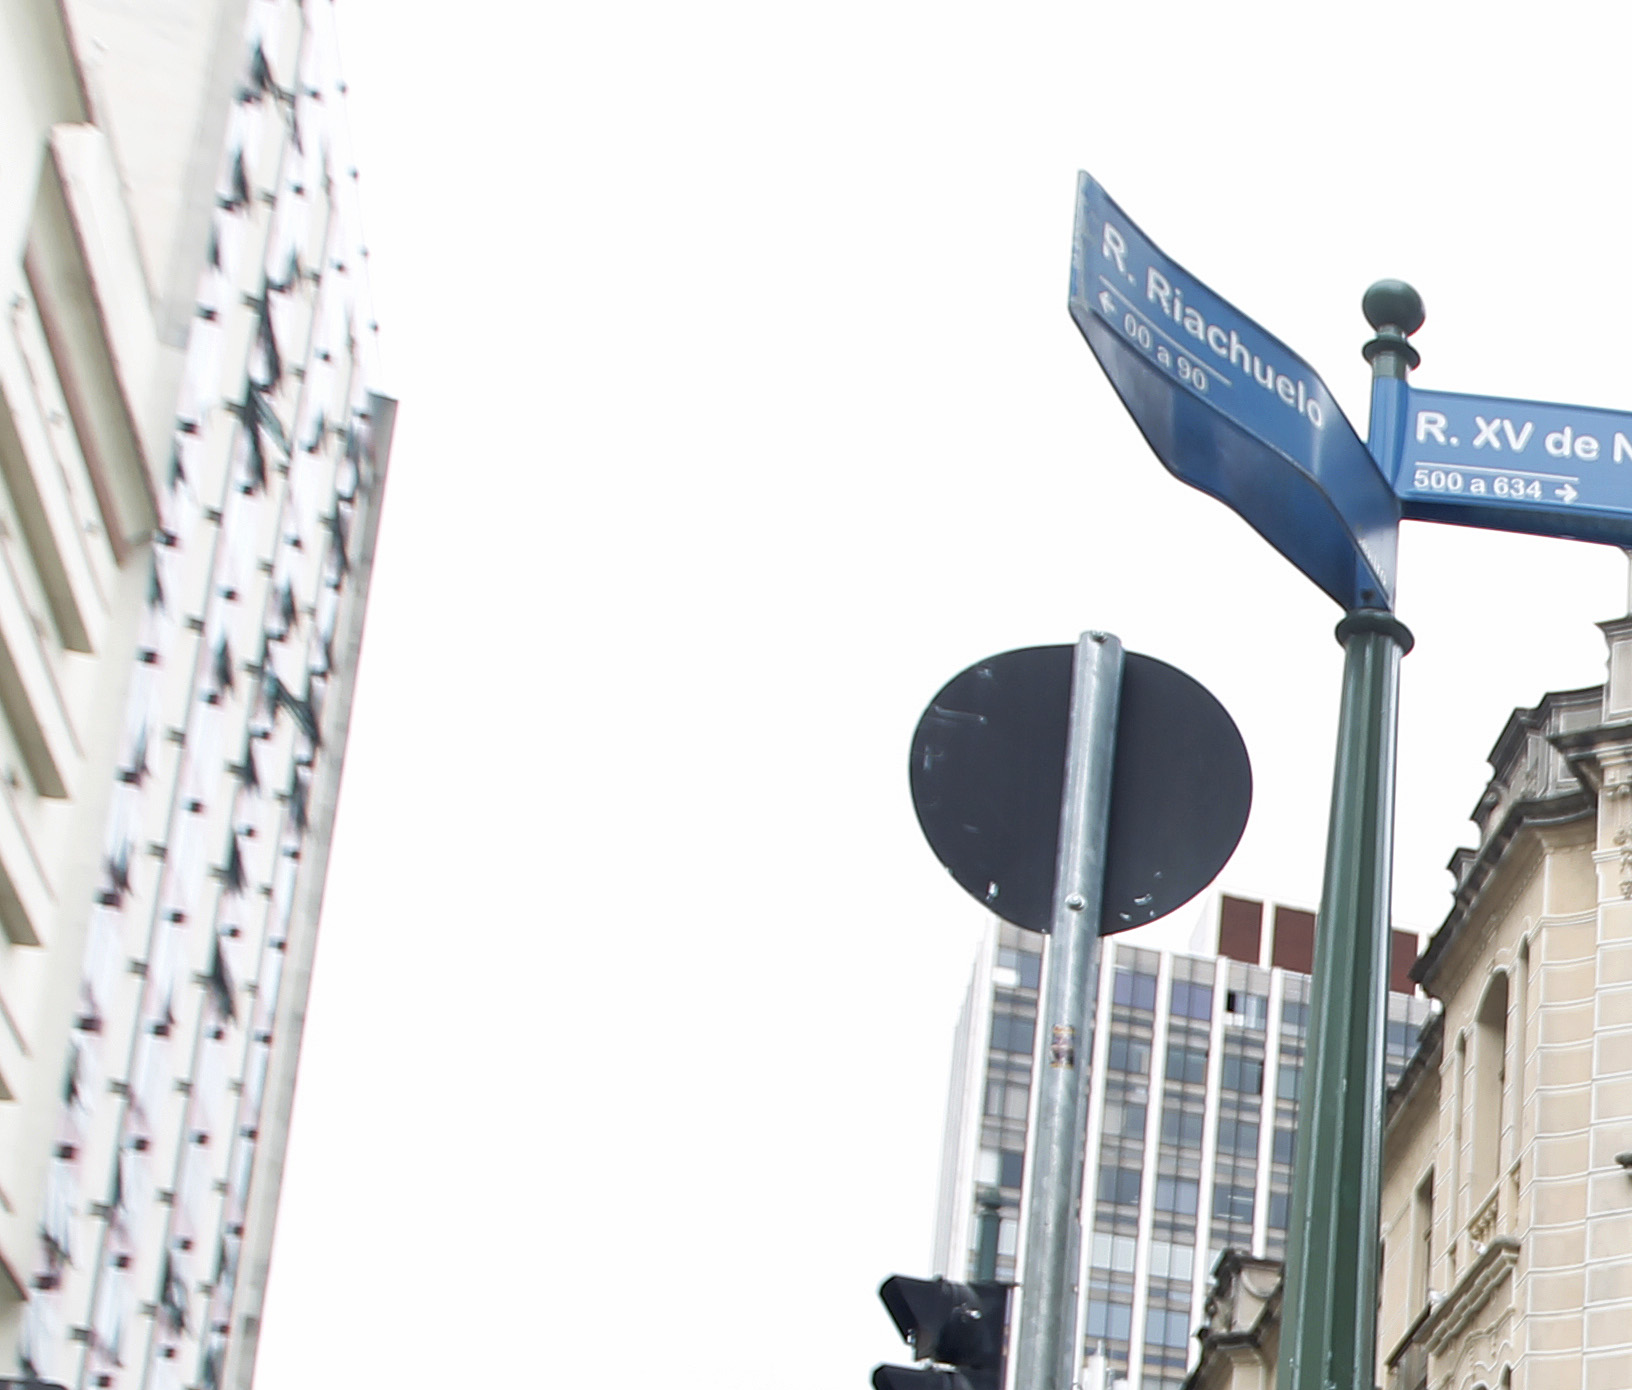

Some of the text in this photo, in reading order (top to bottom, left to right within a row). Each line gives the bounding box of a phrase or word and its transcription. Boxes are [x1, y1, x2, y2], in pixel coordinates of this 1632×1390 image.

[1102, 221, 1324, 430] R. Riachuelo
[1124, 312, 1208, 393] 00 a 90
[1415, 410, 1460, 447] R.
[1472, 415, 1535, 453] XV
[1544, 425, 1600, 462] de
[1413, 469, 1542, 501] 500 a 634
